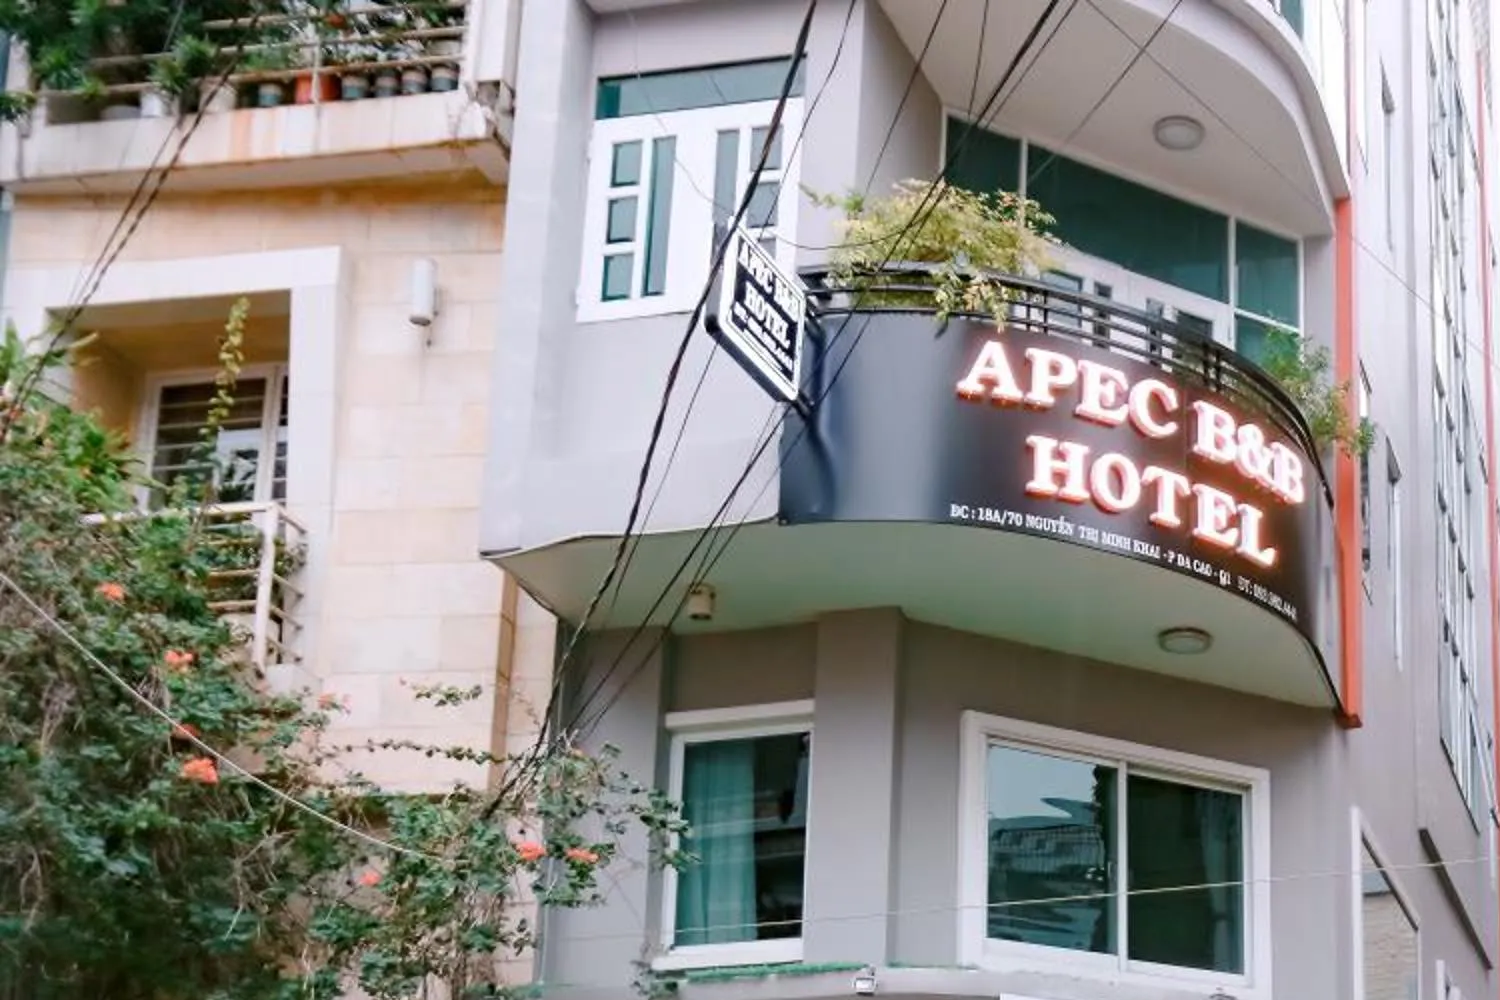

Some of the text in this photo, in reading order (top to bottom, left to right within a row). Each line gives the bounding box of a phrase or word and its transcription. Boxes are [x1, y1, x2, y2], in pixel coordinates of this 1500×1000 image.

[745, 281, 791, 349] HOTEL
[956, 339, 1306, 503] APEC B&B
[978, 507, 1023, 527] 18A/70
[1101, 531, 1131, 551] MINH
[1133, 539, 1161, 559] KHAI
[1025, 434, 1279, 569] HOTEL
